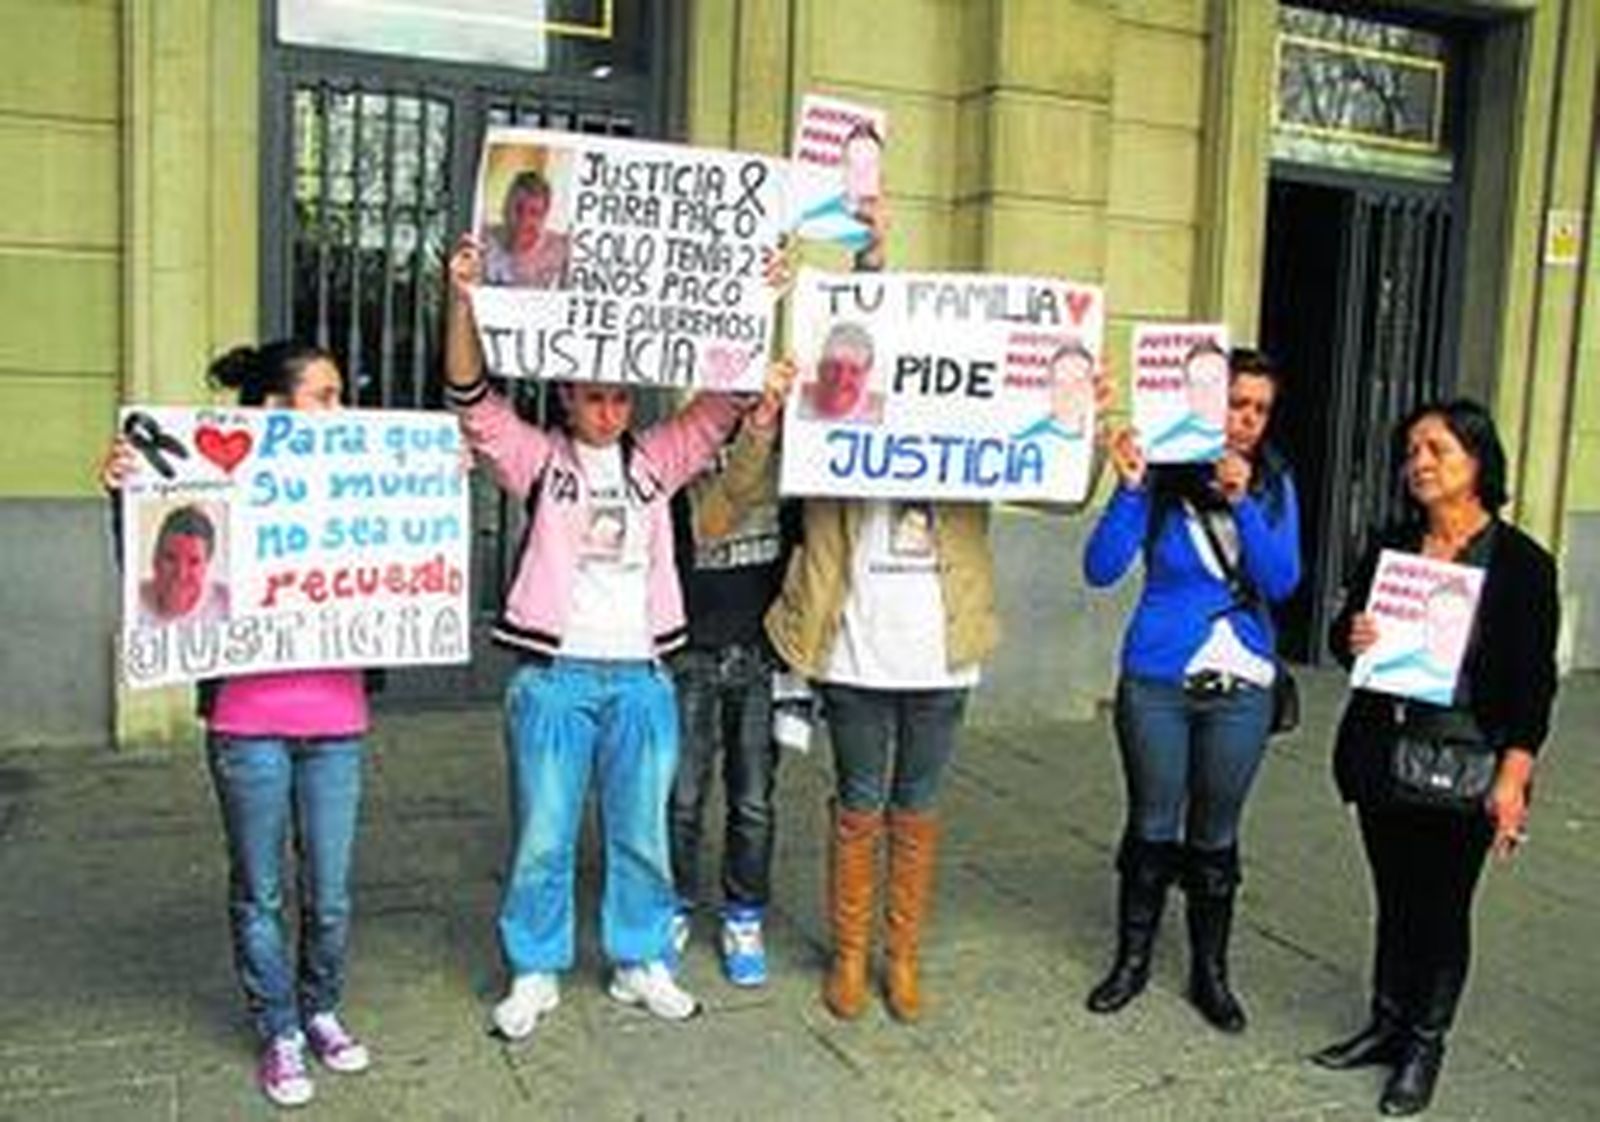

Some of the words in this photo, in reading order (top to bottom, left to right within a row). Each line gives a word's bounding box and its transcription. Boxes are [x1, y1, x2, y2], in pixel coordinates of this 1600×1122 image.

[579, 151, 726, 200] JUSTICIA
[575, 190, 660, 230] PARA
[667, 198, 756, 239] PACO
[572, 230, 656, 270] SOLO
[659, 272, 742, 307] PACO
[817, 281, 885, 315] TU
[906, 280, 1060, 325] FAMILIA
[482, 324, 697, 384] JUSTICIA
[893, 355, 997, 399] PIDE
[258, 414, 368, 458] Para
[826, 429, 1044, 487] JUSTICIA
[255, 523, 310, 560] no
[401, 514, 460, 545] un
[260, 553, 463, 606] recuerdo
